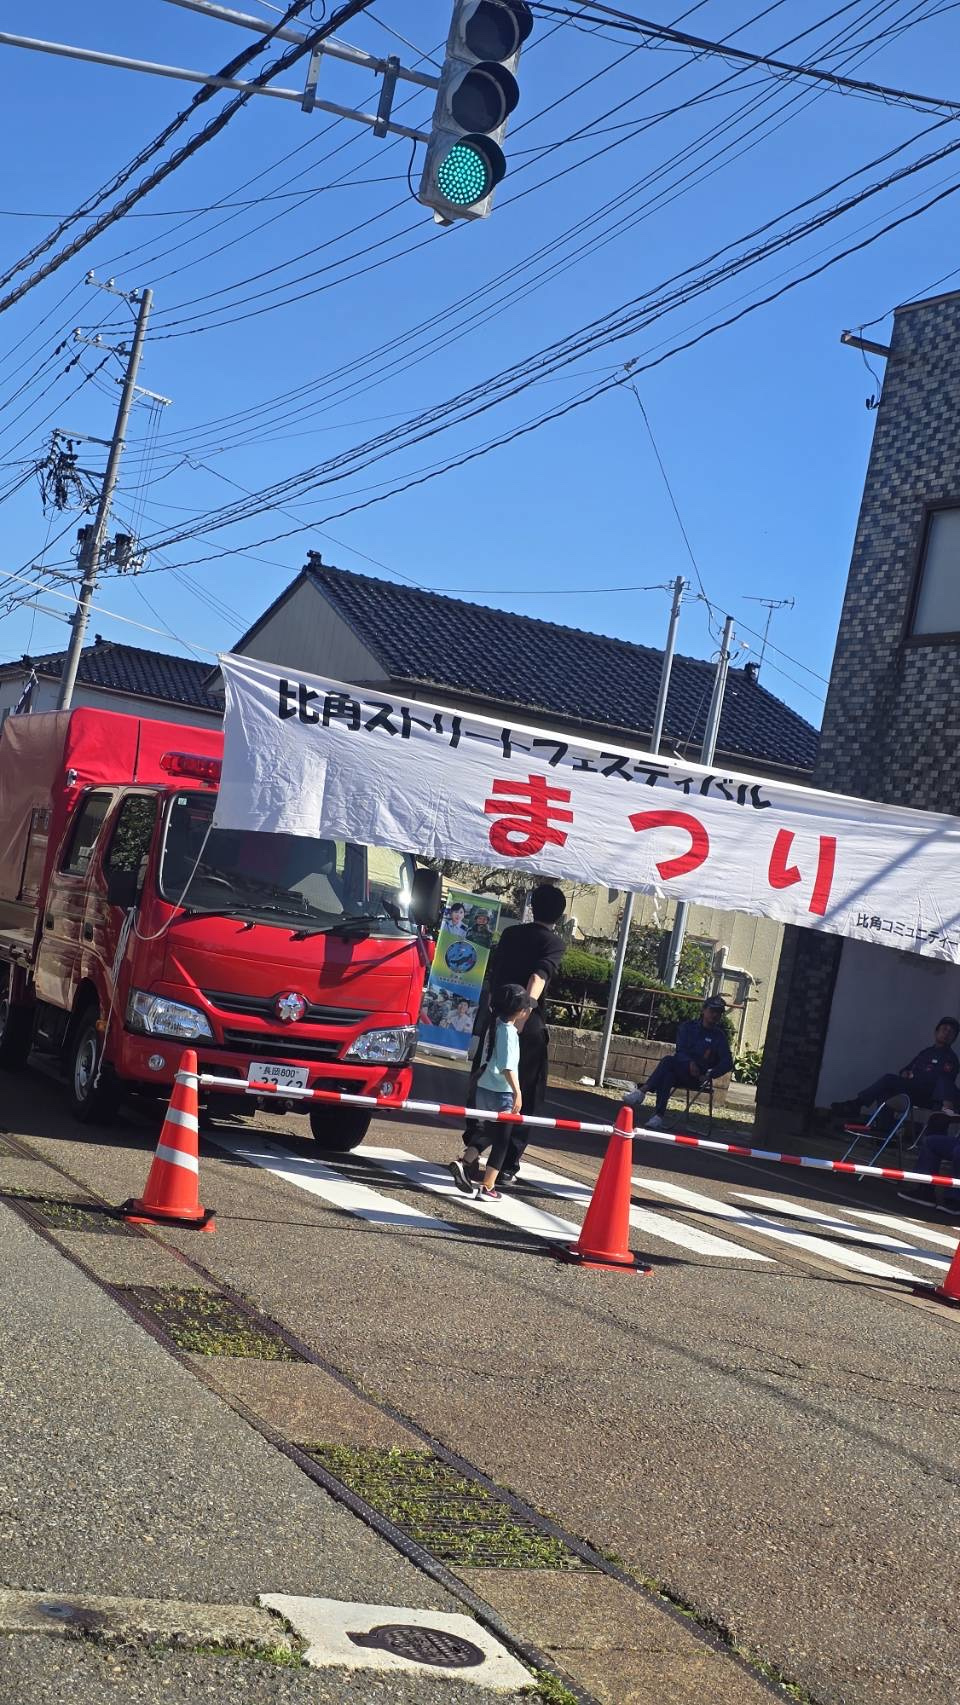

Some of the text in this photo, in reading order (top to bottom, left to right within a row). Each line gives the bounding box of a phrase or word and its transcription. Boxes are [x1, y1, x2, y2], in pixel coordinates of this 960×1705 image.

[279, 679, 772, 809] 比角ストリートフェスティバル
[484, 774, 837, 916] まつり
